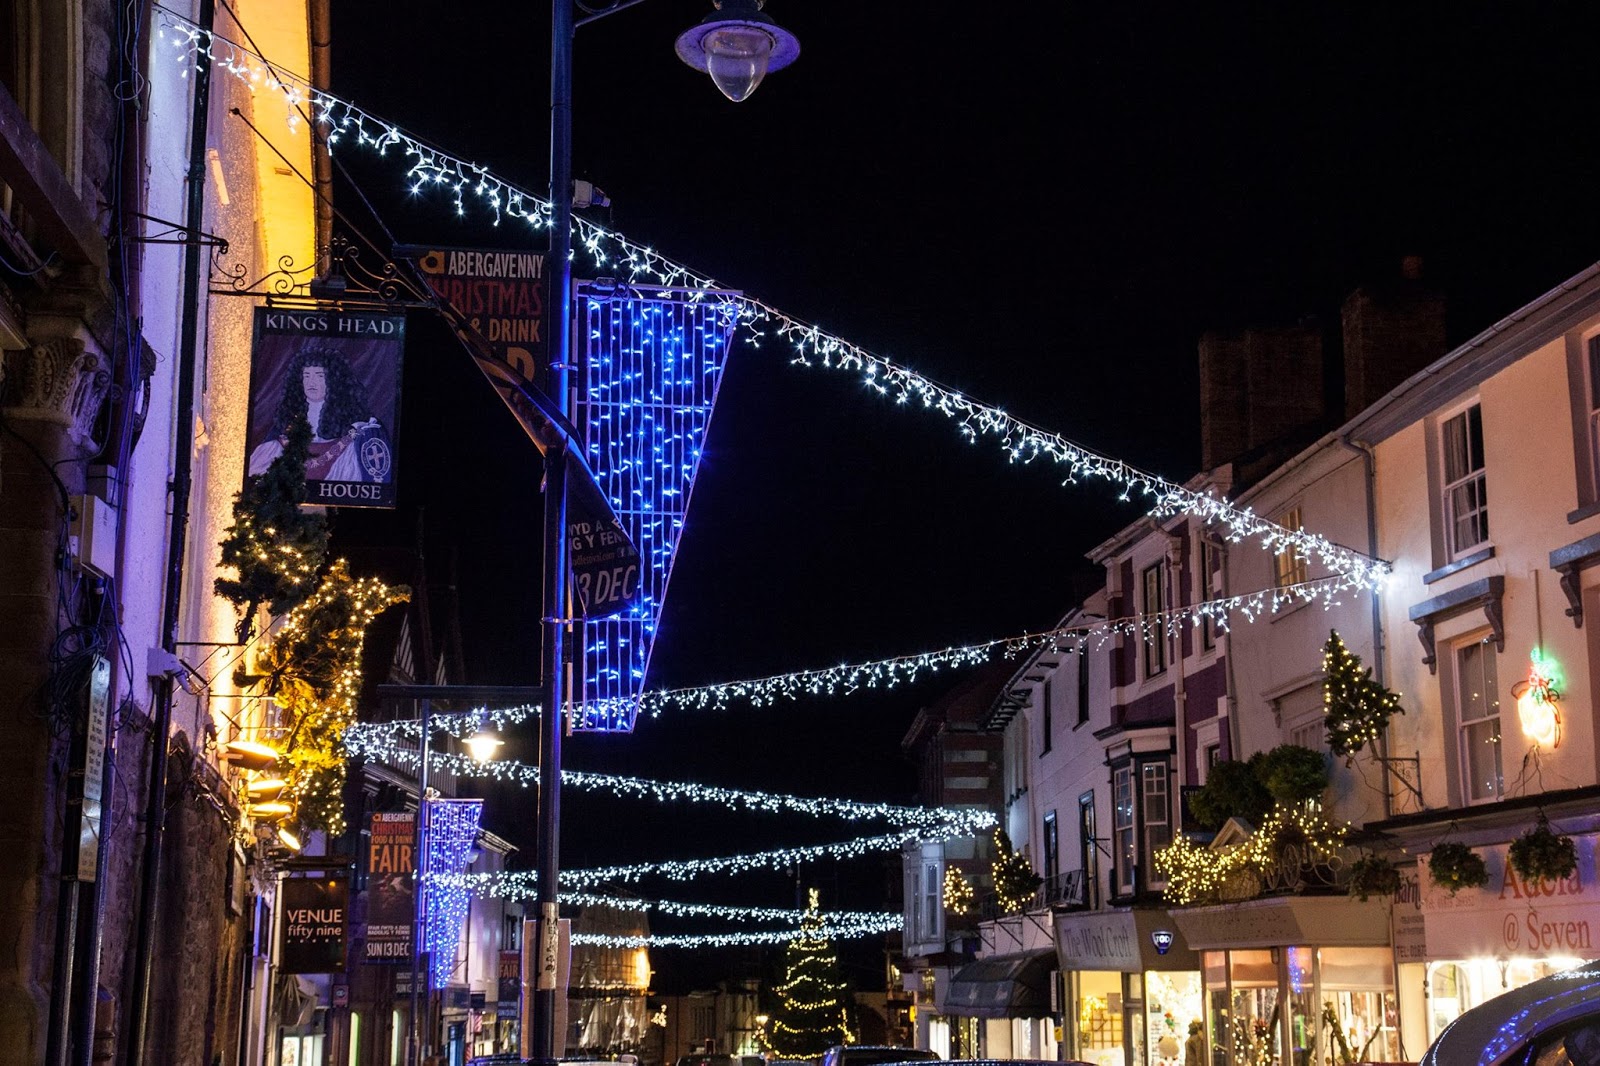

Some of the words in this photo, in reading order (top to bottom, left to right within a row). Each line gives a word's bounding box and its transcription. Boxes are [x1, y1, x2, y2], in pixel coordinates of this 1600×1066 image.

[448, 250, 544, 279] ABERGAVENNY
[266, 313, 328, 331] KINGS
[338, 318, 394, 335] HEAD
[489, 318, 541, 342] DRINK
[319, 483, 381, 500] HOUSE
[585, 534, 595, 548] Y
[595, 565, 636, 605] DEC
[371, 835, 388, 844] FOOD
[370, 845, 413, 873] FAIR
[287, 909, 343, 923] VENUE
[288, 925, 314, 939] fifty
[316, 925, 342, 936] nine
[1503, 913, 1520, 950] @
[1526, 911, 1592, 950] Seven
[367, 942, 383, 957] SUN
[384, 942, 393, 957] 13
[394, 942, 410, 957] DEC
[1080, 926, 1106, 957] Wool
[1106, 926, 1132, 957] Croft
[500, 964, 518, 978] FAIR
